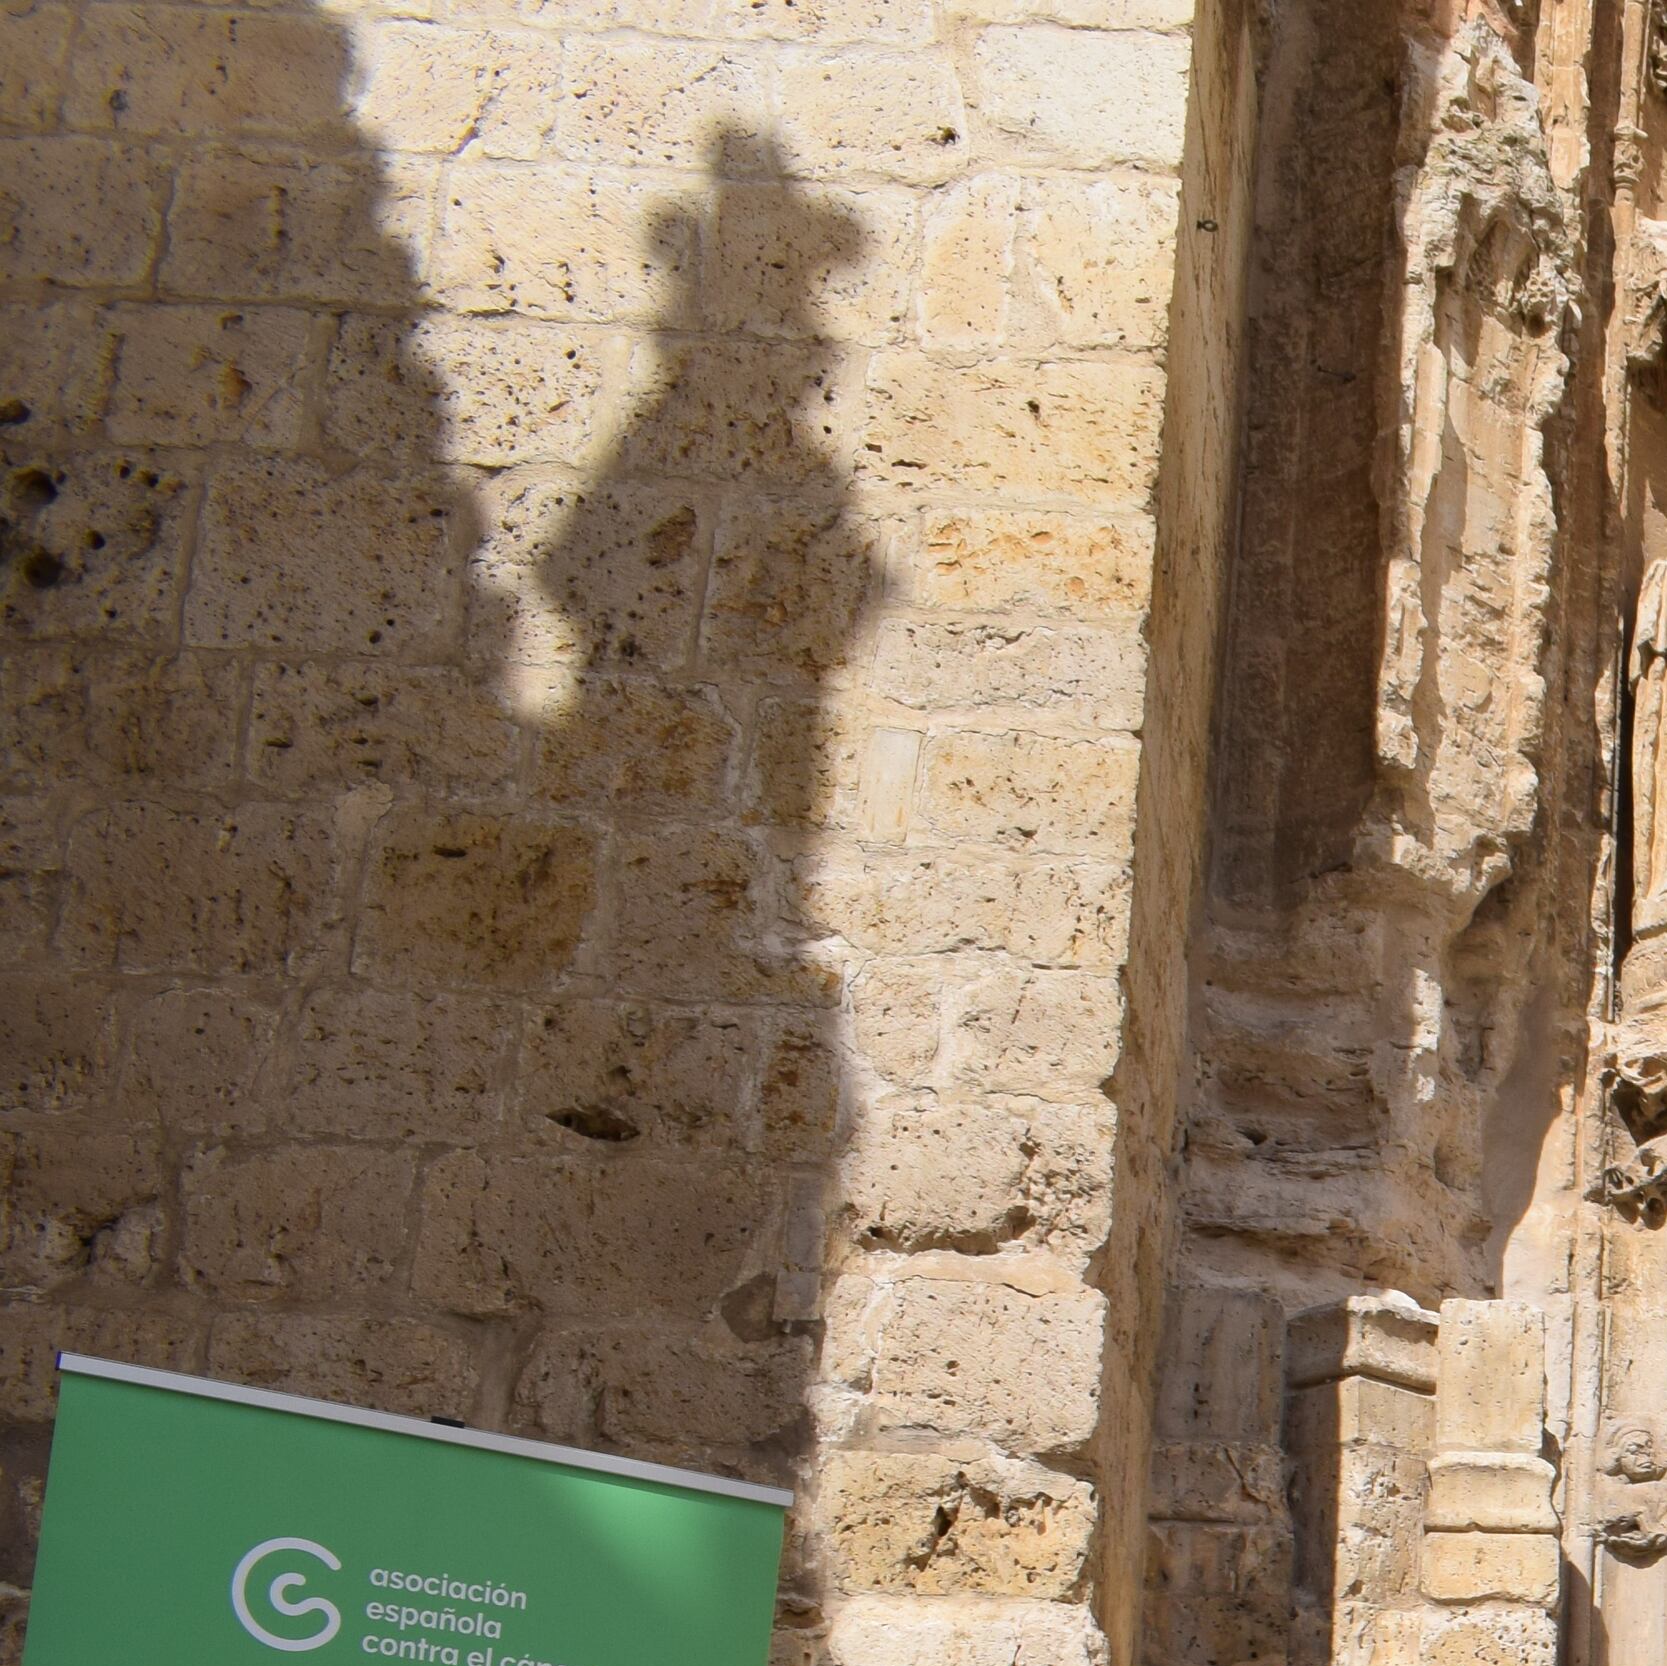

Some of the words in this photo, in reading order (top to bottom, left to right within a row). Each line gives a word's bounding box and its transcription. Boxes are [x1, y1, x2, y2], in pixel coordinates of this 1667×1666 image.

[369, 1568, 527, 1610] asociación
[366, 1601, 502, 1639] española
[362, 1634, 459, 1666] contra
